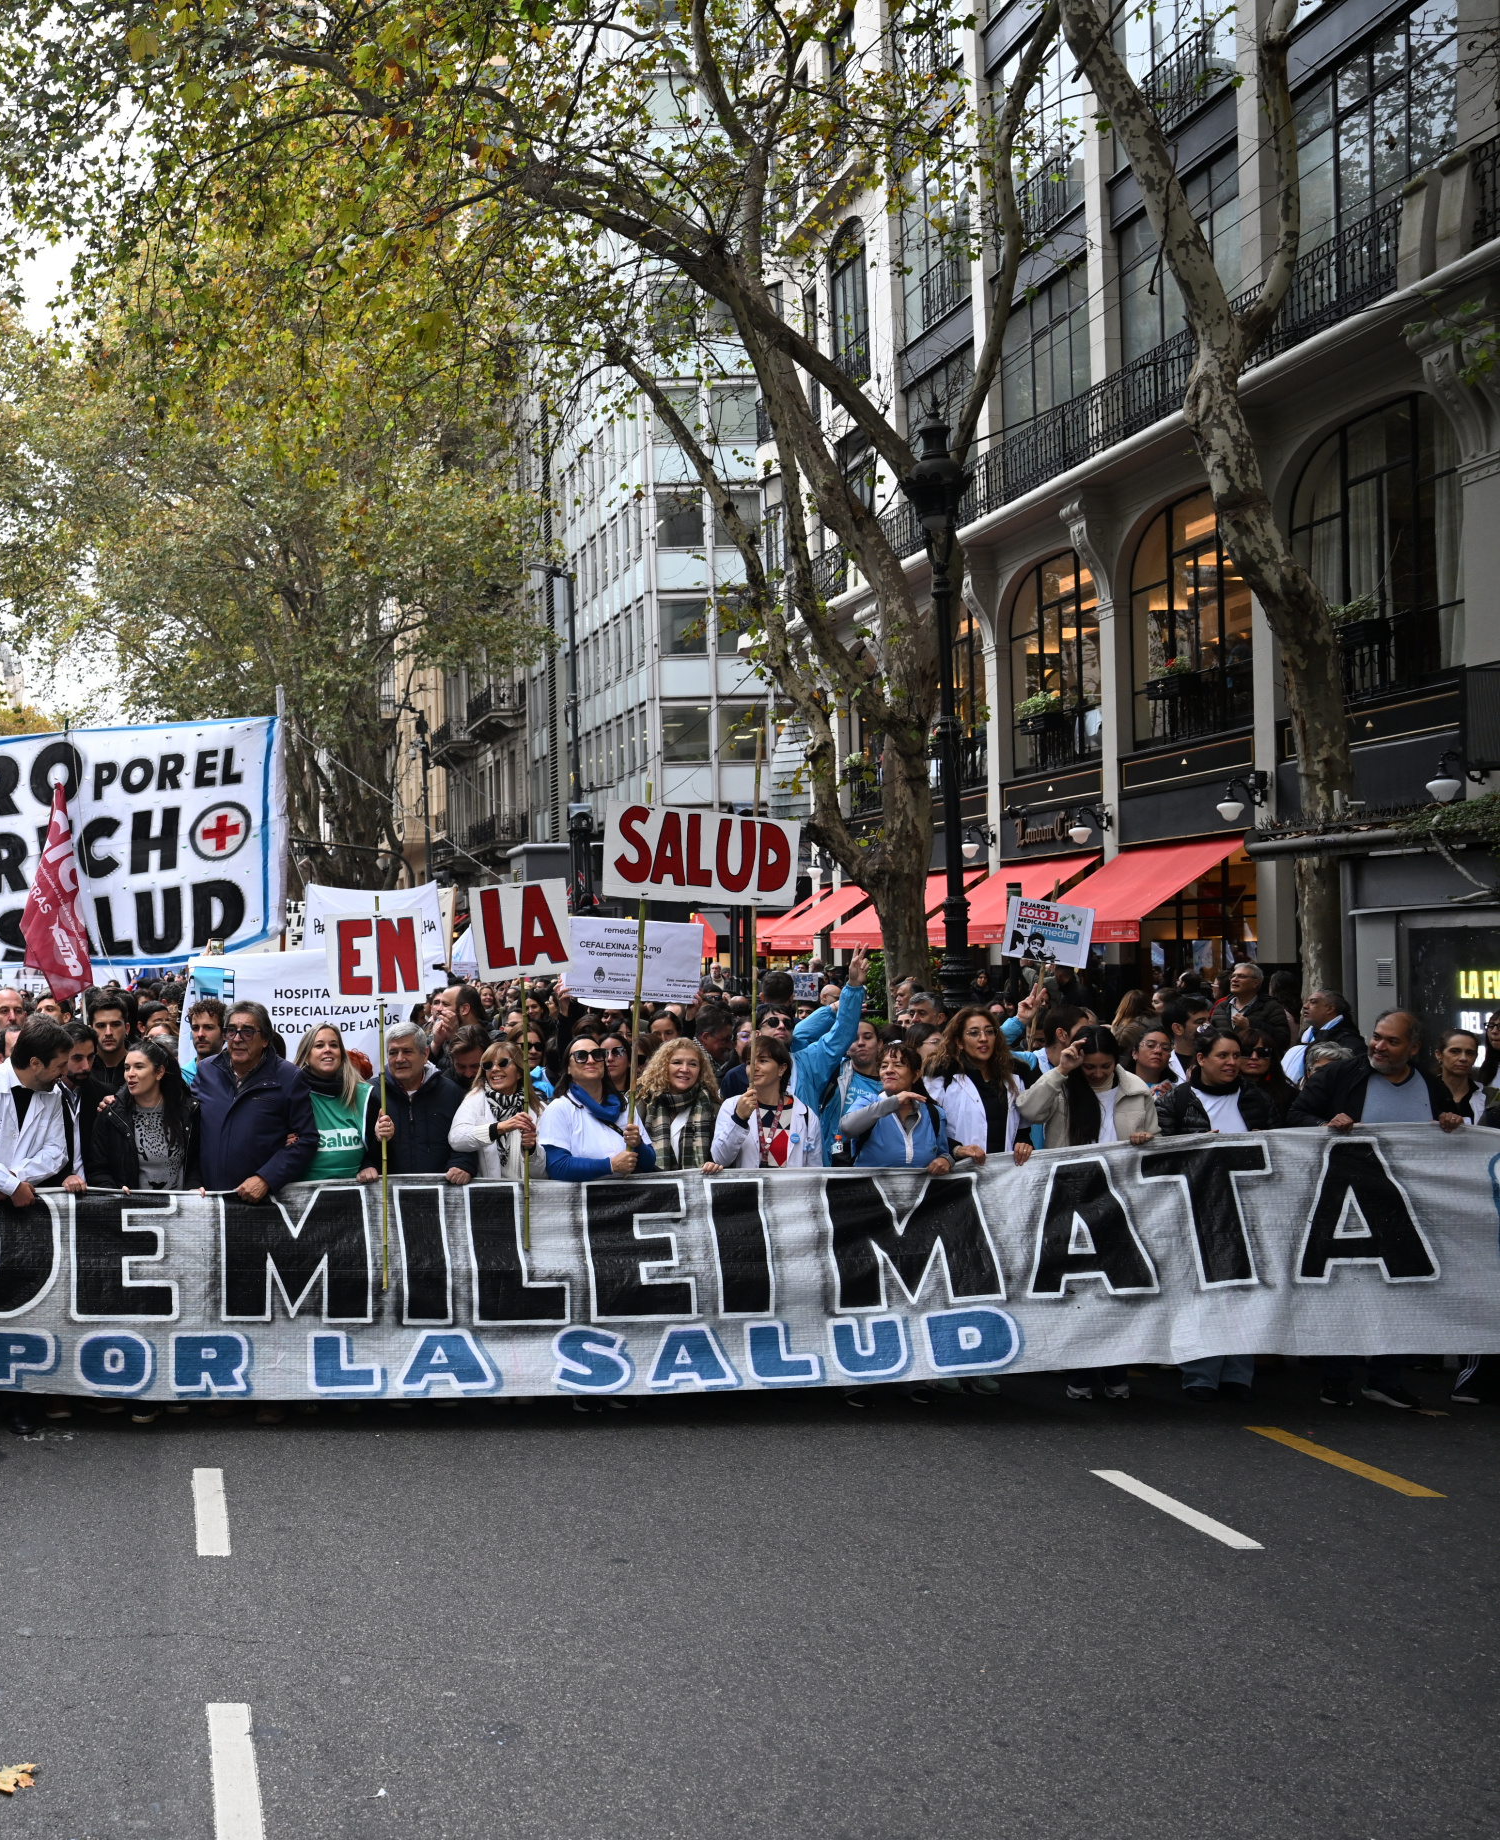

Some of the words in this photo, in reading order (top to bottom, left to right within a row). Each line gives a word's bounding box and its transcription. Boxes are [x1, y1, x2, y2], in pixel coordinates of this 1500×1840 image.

[93, 753, 185, 801] POR
[193, 747, 243, 789] EL
[614, 805, 791, 893] SALUD
[1020, 901, 1051, 911] DEJARON
[1021, 908, 1047, 919] SOLO
[1049, 913, 1056, 921] 3
[480, 884, 569, 970] LA
[1018, 917, 1069, 930] MEDICAMENTOS
[604, 927, 639, 936] remediar
[1032, 926, 1077, 940] remediar
[580, 940, 631, 951] CEFALEXINA
[632, 944, 648, 952] 20
[337, 916, 420, 996] EN
[596, 951, 634, 959] comprimidos
[1460, 970, 1480, 999] LA
[274, 988, 330, 999] HOSPITA
[271, 1005, 370, 1016] ESPECIALIZADO
[340, 1021, 356, 1032] DE
[1461, 1011, 1484, 1034] DEL
[220, 1177, 775, 1325] MILEI
[821, 1137, 1440, 1314] MATA
[306, 1328, 501, 1394] LA
[552, 1306, 1020, 1392] SALUD
